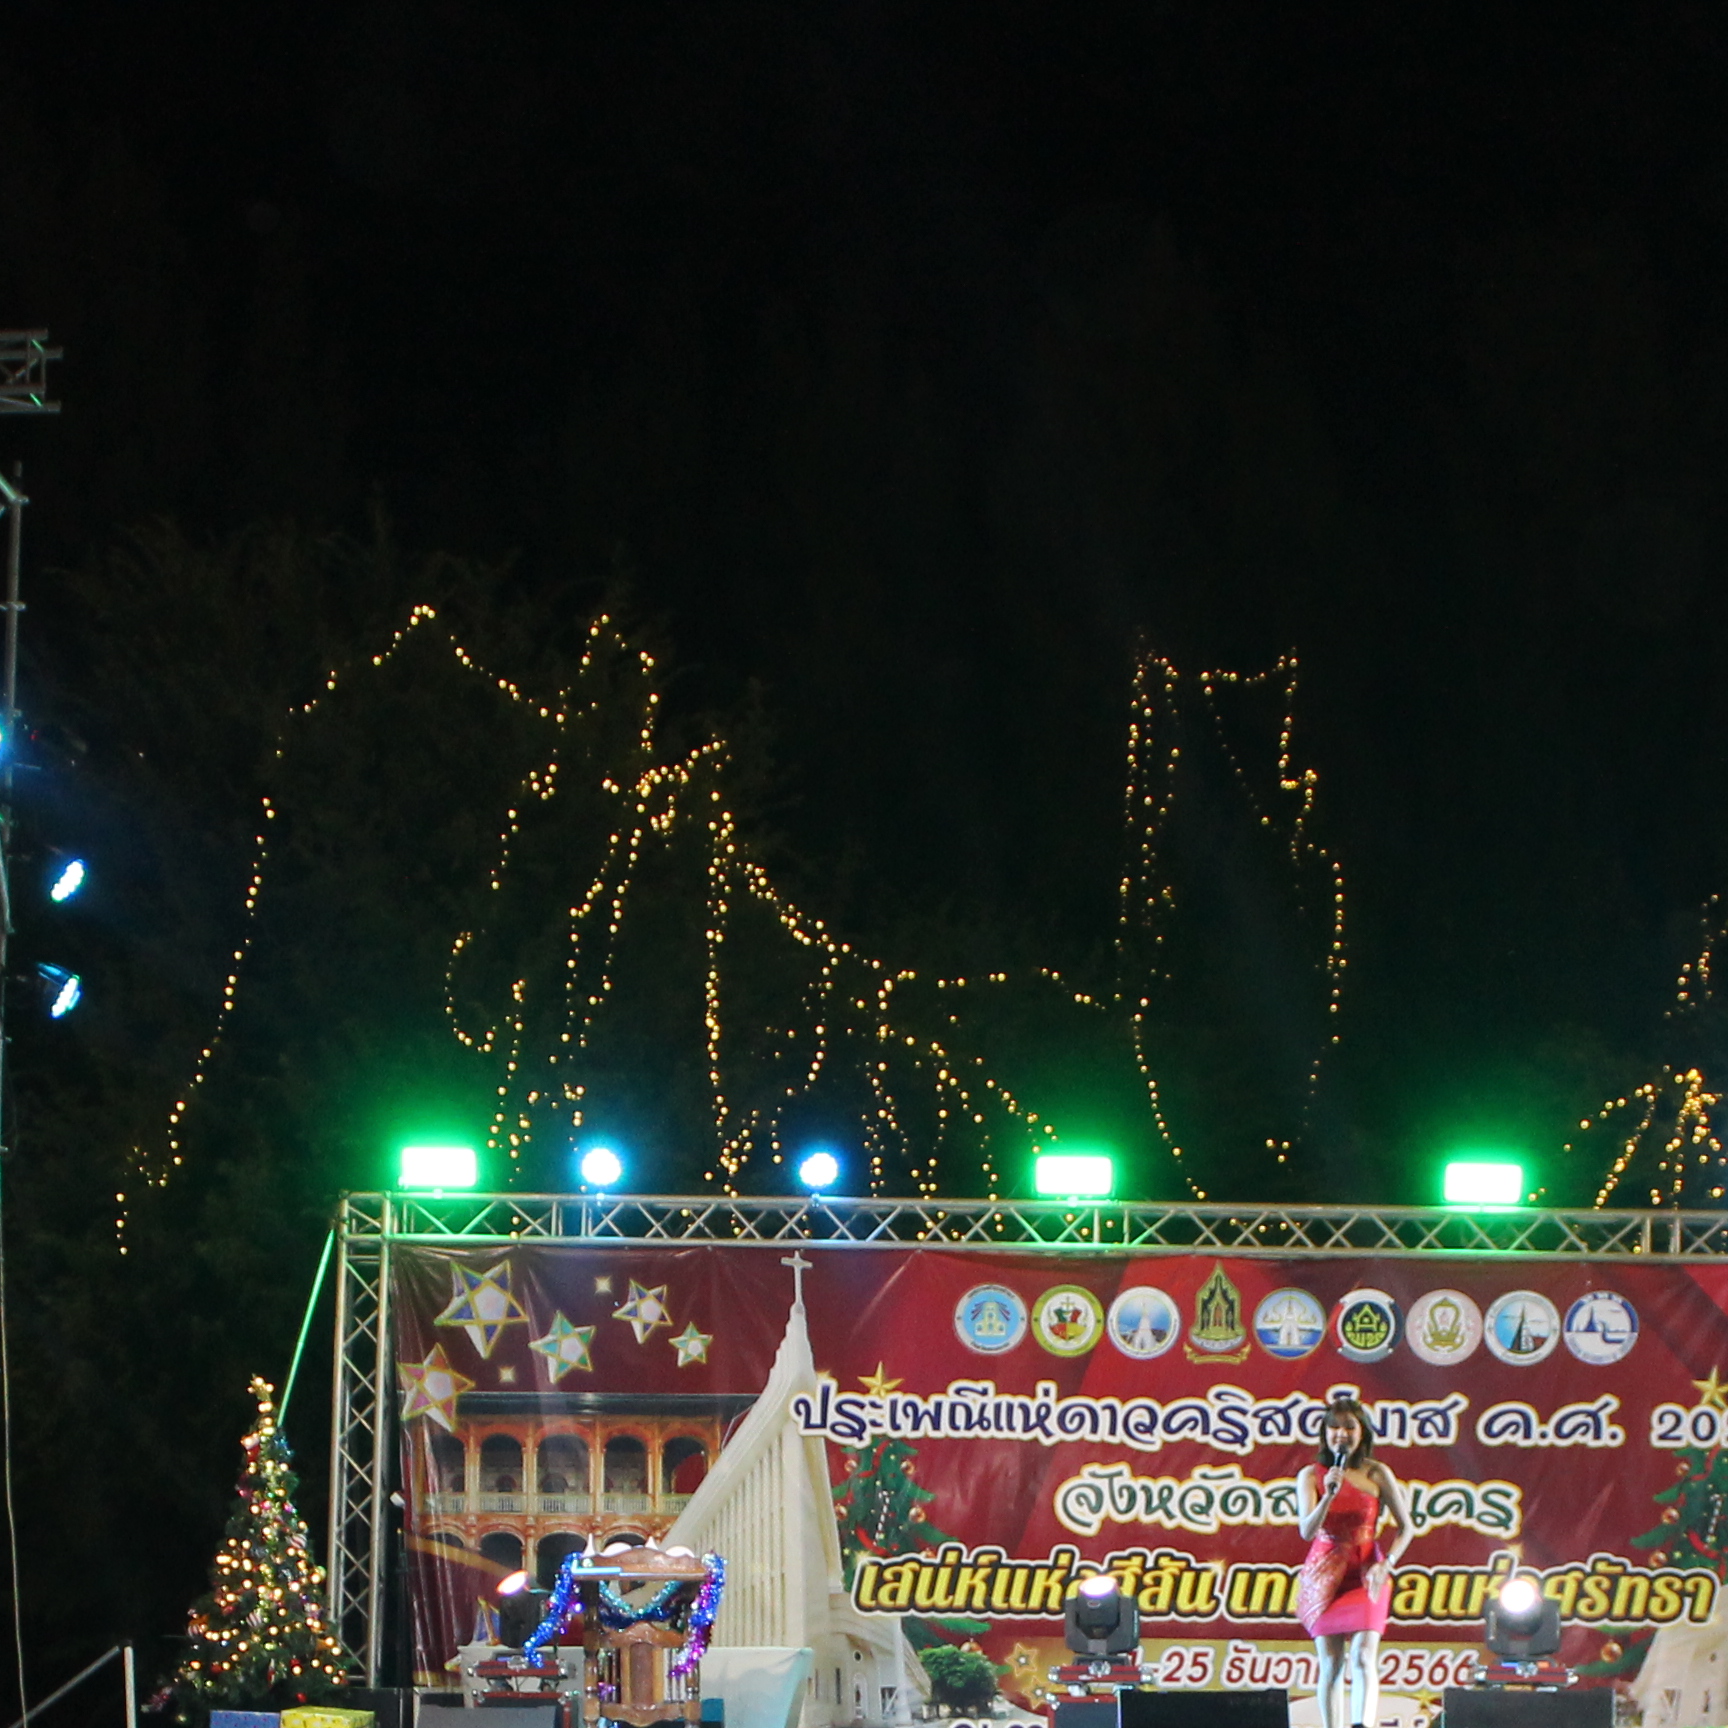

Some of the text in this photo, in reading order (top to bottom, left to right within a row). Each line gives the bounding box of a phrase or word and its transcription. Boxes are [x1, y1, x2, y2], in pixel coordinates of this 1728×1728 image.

[1483, 1399, 1620, 1441] ค.ศ.
[1060, 1468, 1515, 1531] จังหวัดสนคร
[1379, 1653, 1475, 1686] 2566
